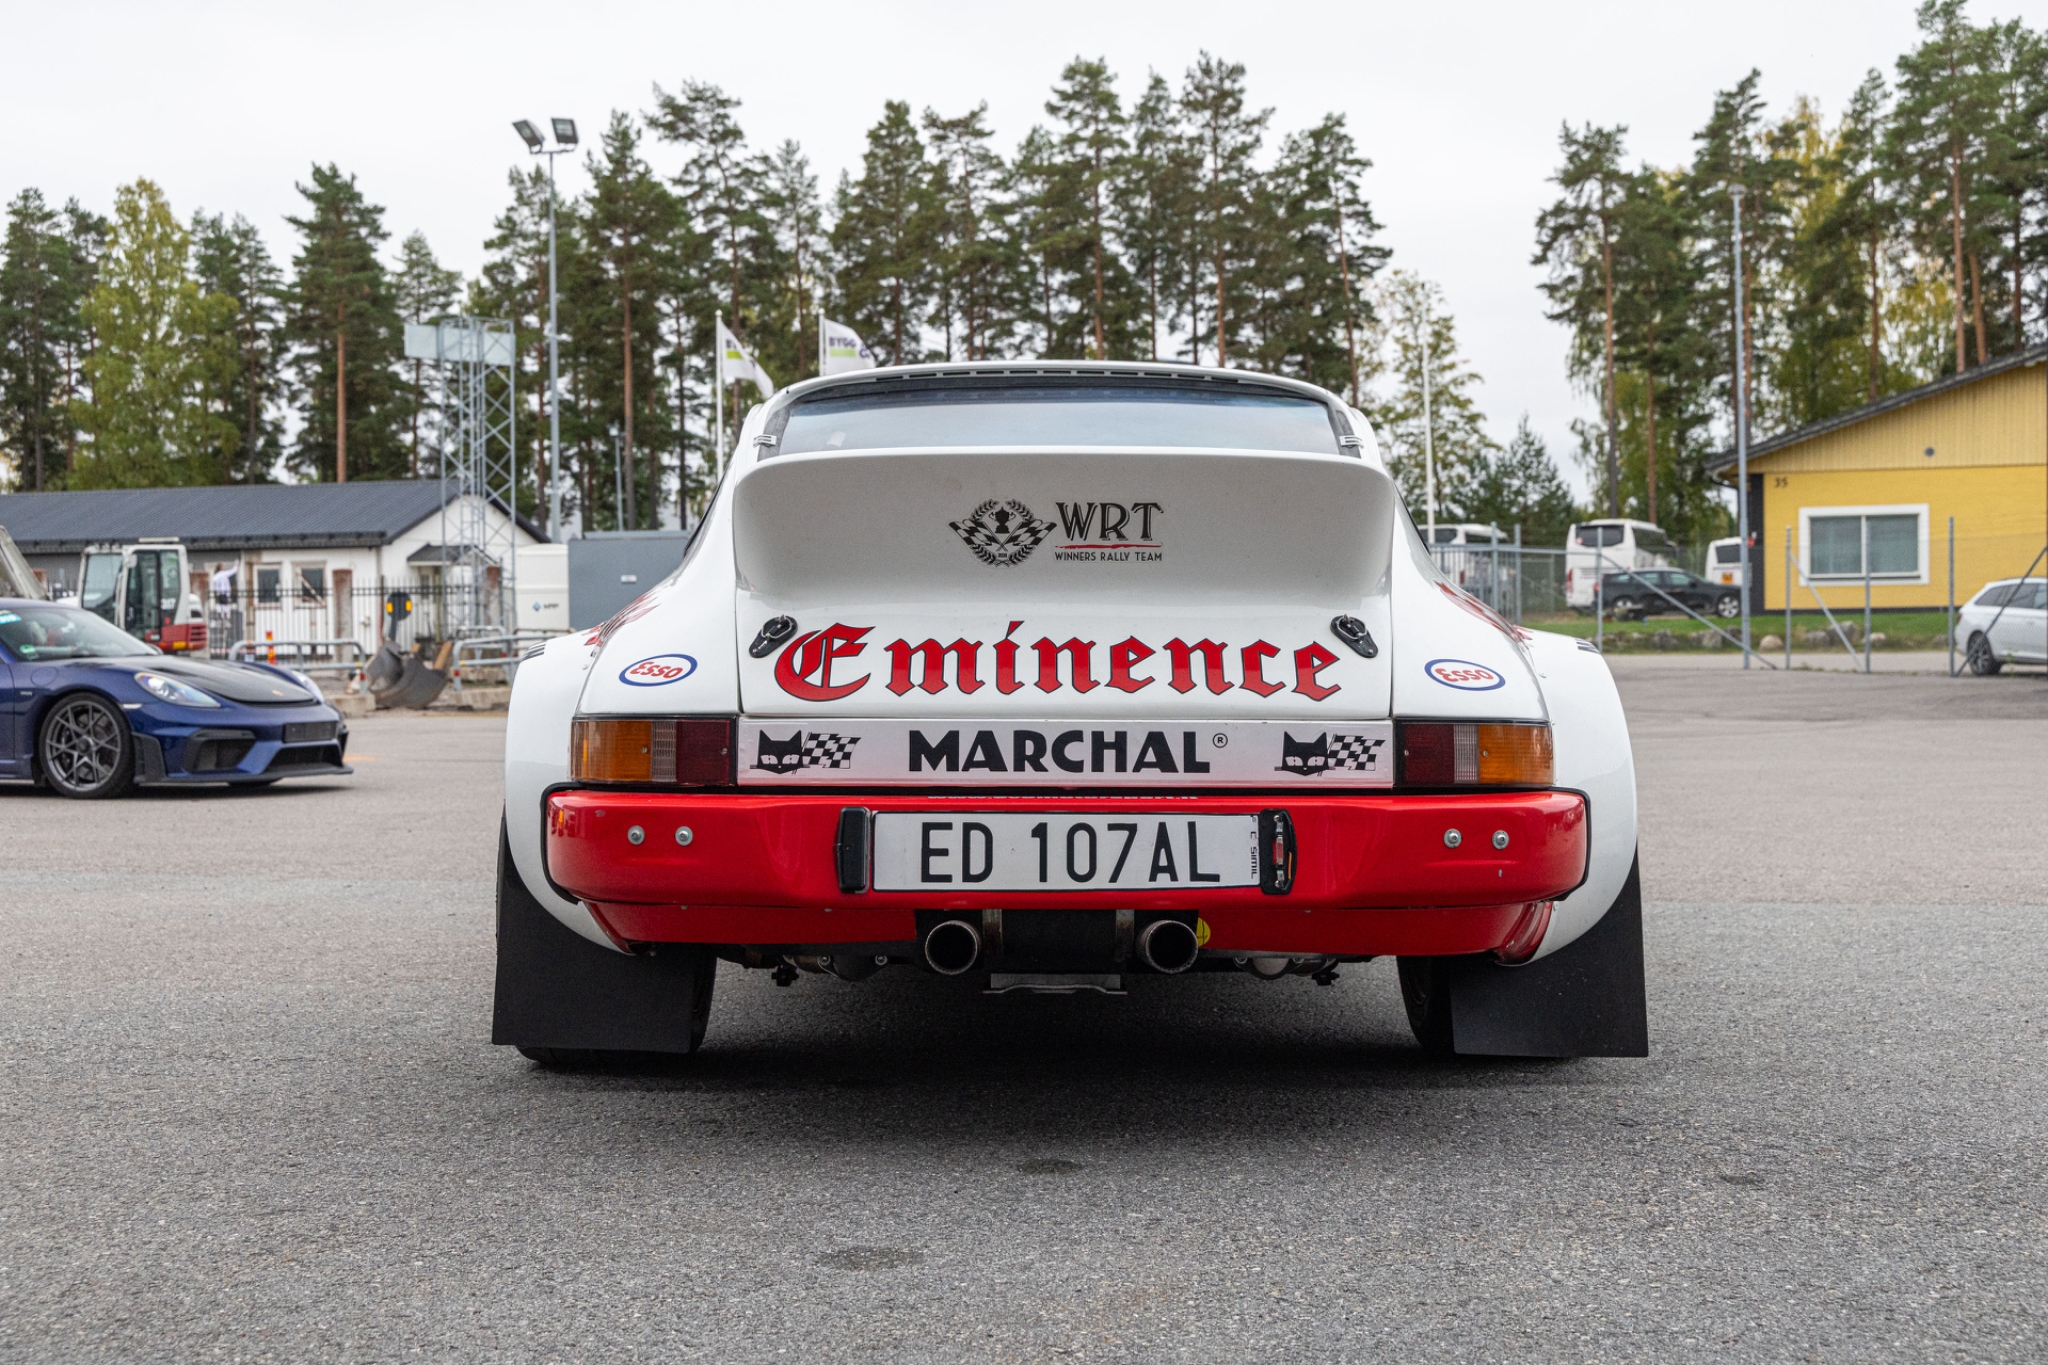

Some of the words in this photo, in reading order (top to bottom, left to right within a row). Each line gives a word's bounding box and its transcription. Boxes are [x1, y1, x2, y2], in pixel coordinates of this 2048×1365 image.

[828, 336, 856, 348] BYGG
[1054, 502, 1164, 541] WRT
[1055, 551, 1097, 562] WINNERS
[1100, 551, 1130, 562] RALLY
[1135, 551, 1163, 562] TEAM
[921, 822, 993, 883] ED
